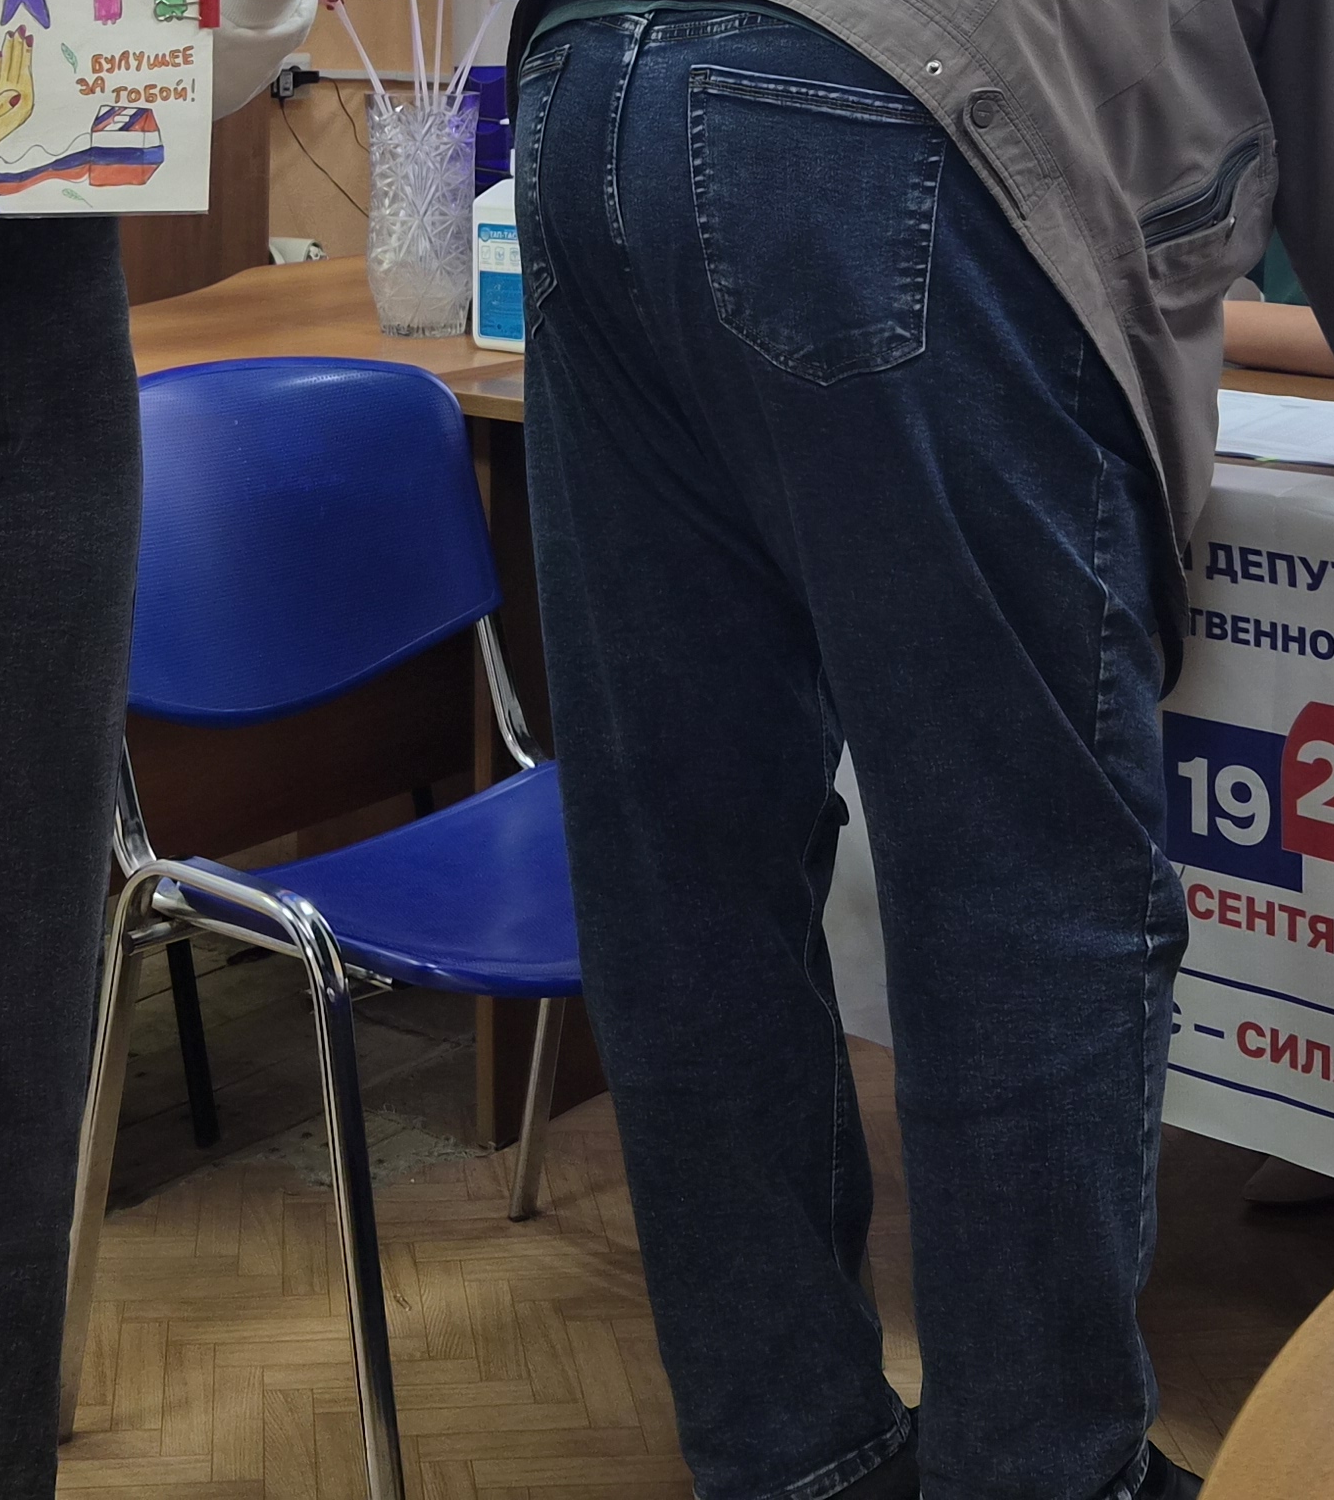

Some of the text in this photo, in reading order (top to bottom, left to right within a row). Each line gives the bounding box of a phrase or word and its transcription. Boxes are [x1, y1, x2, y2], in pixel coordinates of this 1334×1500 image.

[76, 75, 196, 104] ЗА ТОБОЙ!
[1177, 756, 1271, 846] 19
